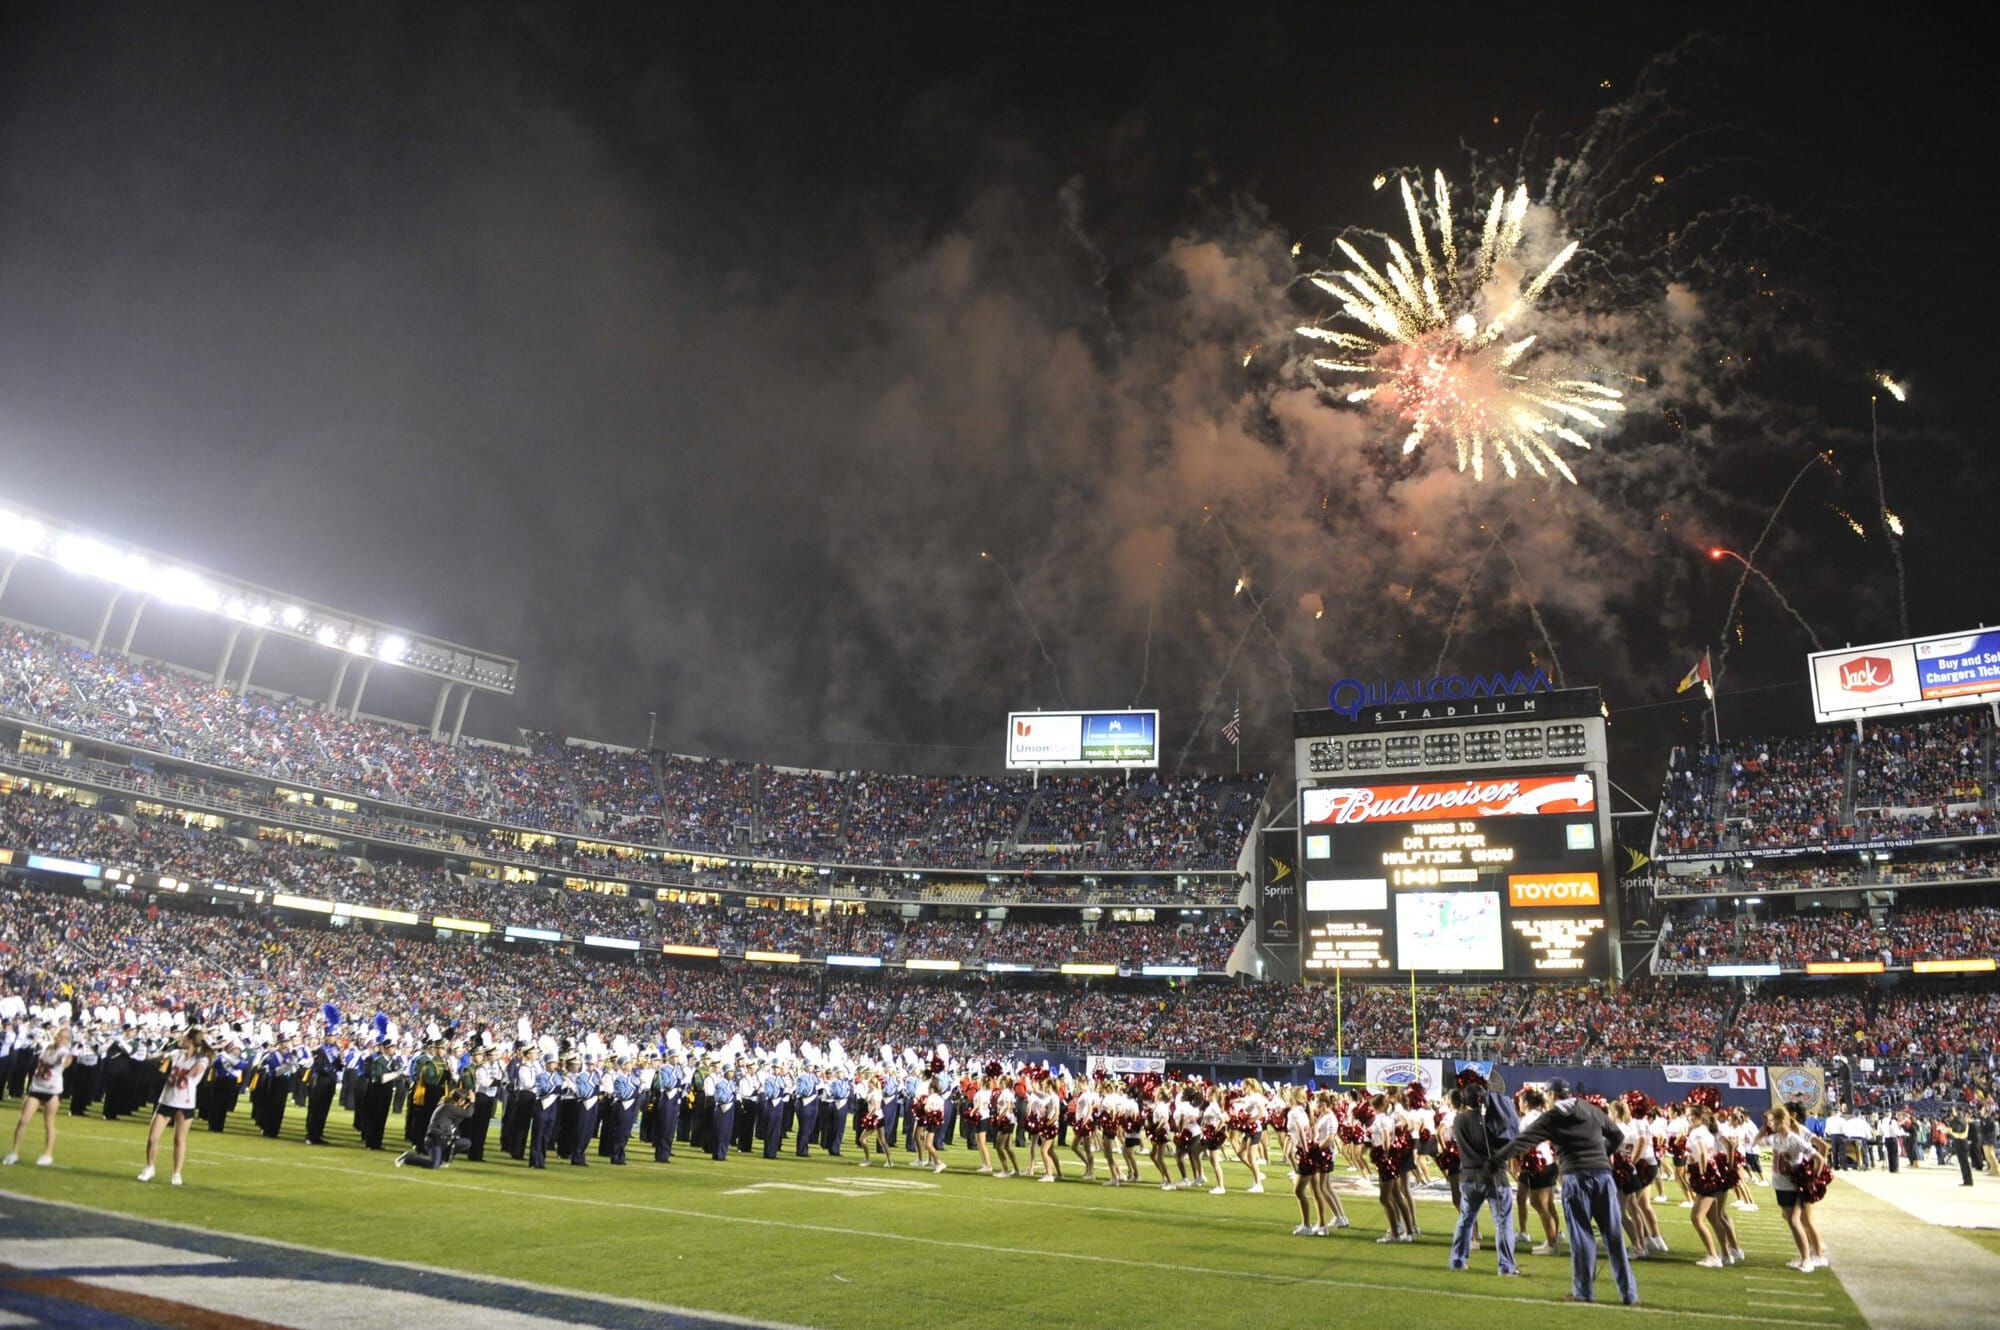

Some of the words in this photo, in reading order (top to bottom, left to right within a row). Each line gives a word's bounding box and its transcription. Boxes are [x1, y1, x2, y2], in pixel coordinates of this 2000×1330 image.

[1938, 658, 1959, 673] Buy
[1961, 653, 1981, 667] and
[1842, 660, 1891, 690] Jack
[1926, 667, 1976, 685] Chargers
[1329, 668, 1554, 721] QUALCOMM
[1375, 700, 1535, 721] STADIUM
[1334, 780, 1519, 824] Budweiser
[1412, 823, 1456, 835] THANKS
[1459, 822, 1476, 833] TO
[1403, 837, 1424, 850] DR
[1429, 834, 1486, 849] PEPPER
[1382, 850, 1463, 865] HALFTIME
[1471, 847, 1514, 862] SHOW
[1264, 885, 1294, 897] Sprint
[1513, 881, 1594, 899] TOYOTA
[1735, 1068, 1758, 1087] N
